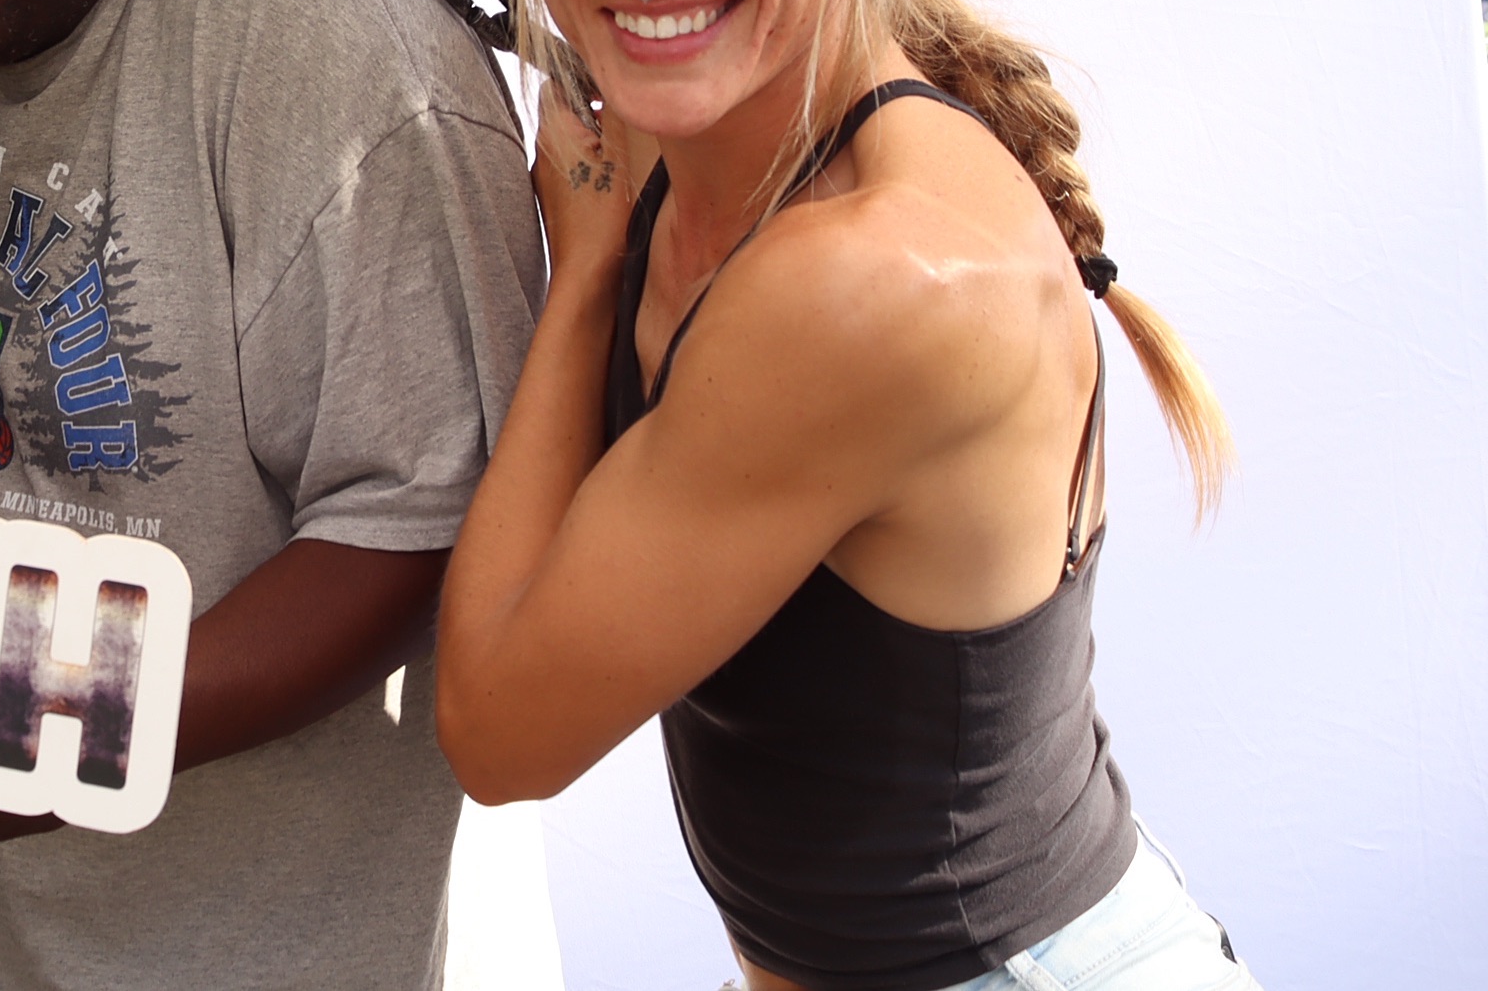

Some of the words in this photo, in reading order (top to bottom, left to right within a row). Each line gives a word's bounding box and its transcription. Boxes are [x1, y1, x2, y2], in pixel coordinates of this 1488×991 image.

[37, 259, 139, 472] FOUR
[0, 491, 119, 534] MINEAPOLIS,
[125, 516, 162, 538] MN
